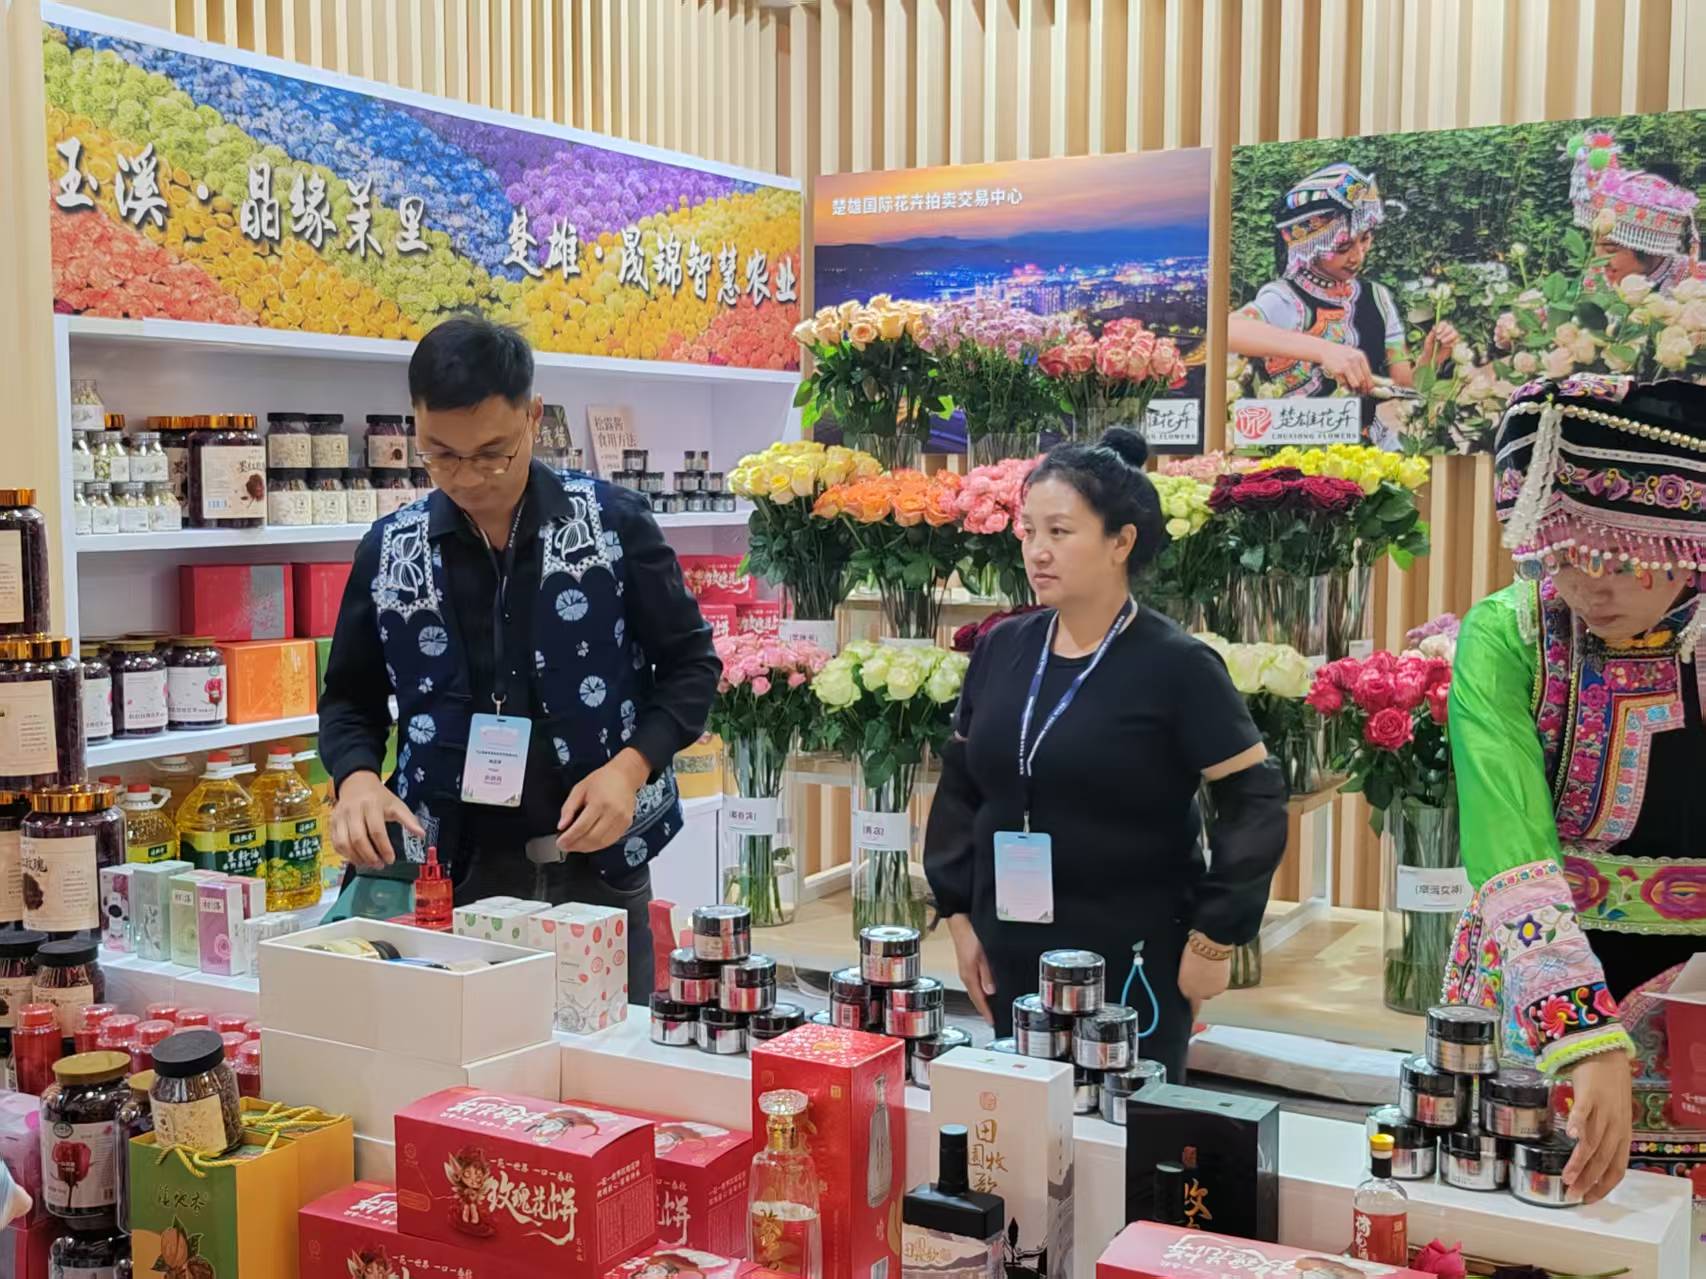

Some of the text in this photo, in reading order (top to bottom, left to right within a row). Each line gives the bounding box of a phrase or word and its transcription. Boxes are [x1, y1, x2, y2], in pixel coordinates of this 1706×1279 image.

[832, 187, 1023, 217] 楚雄国际花卉拍卖交易中心
[1272, 400, 1357, 432] 楚雄花卉
[484, 1170, 578, 1247] 玫瑰花饼
